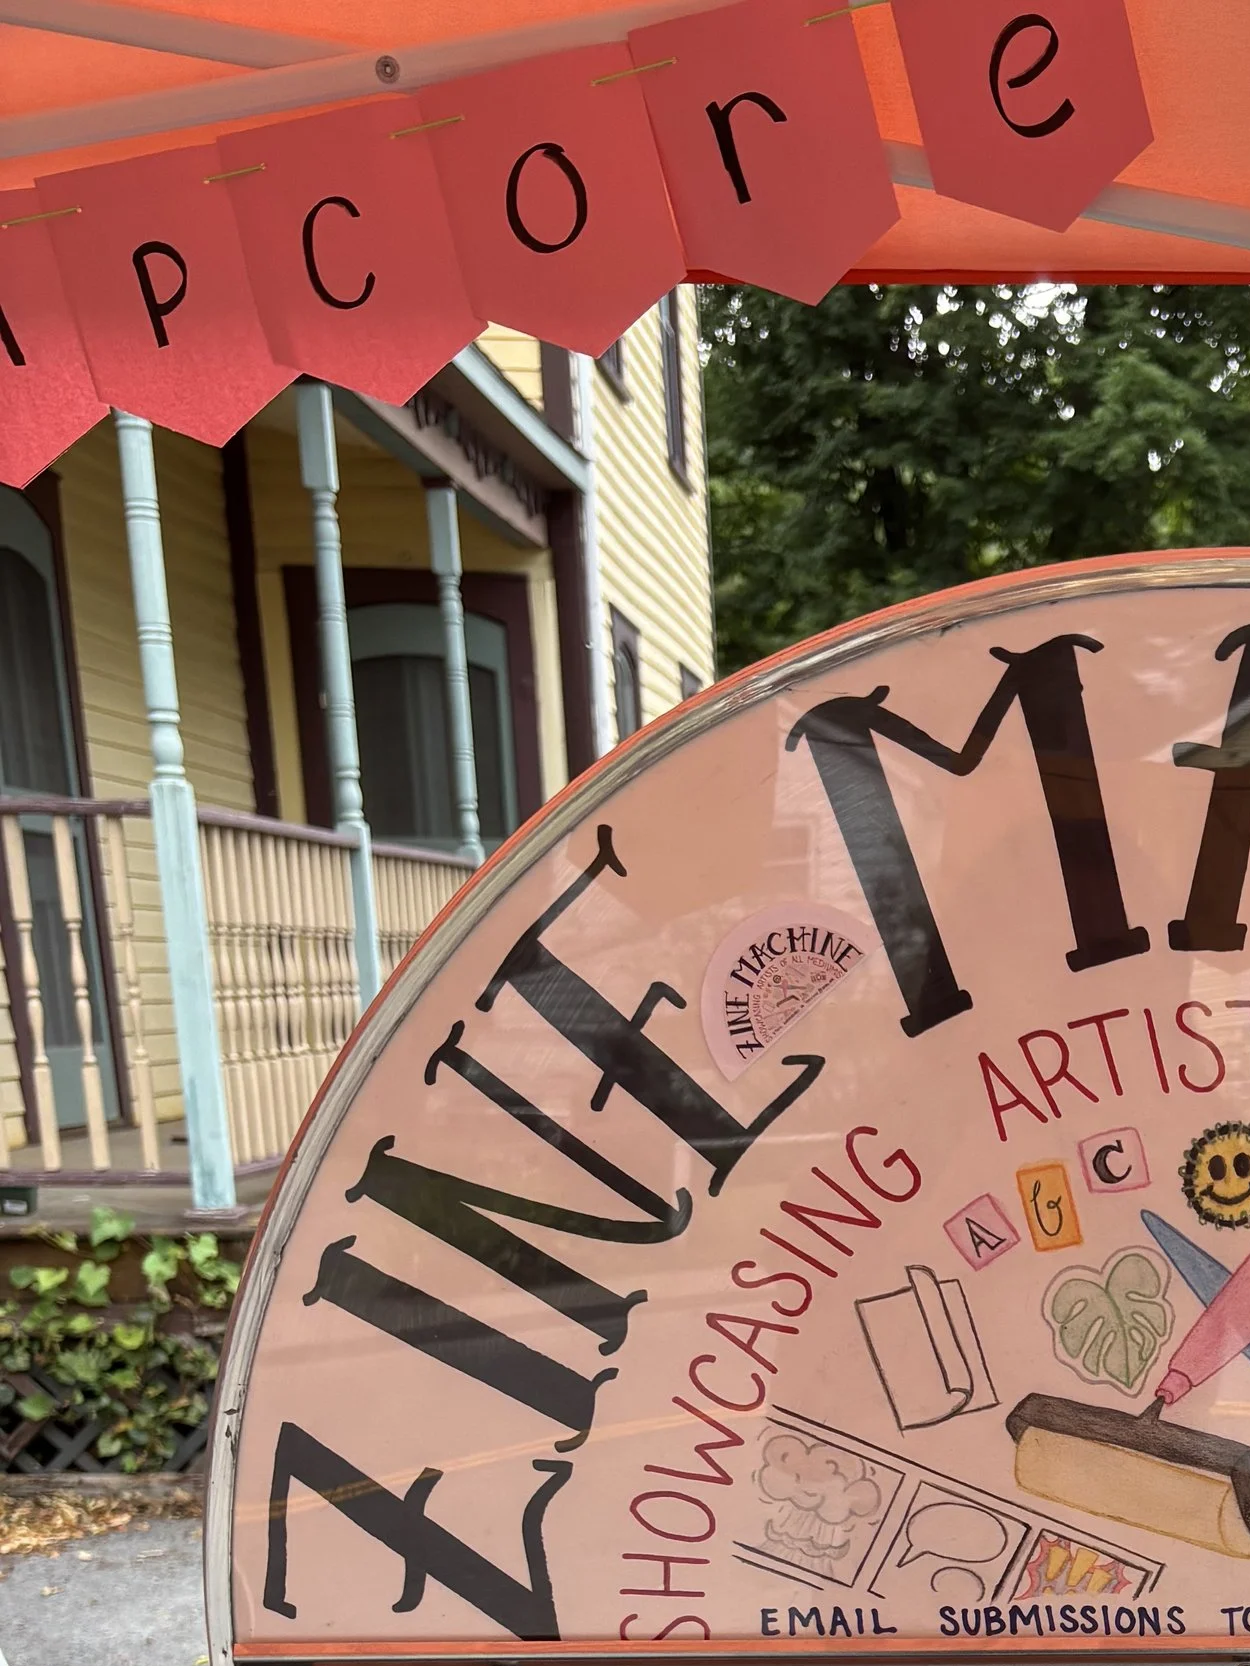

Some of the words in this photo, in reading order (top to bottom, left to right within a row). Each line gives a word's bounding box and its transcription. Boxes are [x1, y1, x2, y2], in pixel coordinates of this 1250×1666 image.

[730, 927, 865, 988] MACHINE
[724, 991, 764, 1059] ZINE
[263, 824, 824, 1641] ZINE
[620, 1126, 922, 1640] SHOWCASING
[761, 1606, 898, 1636] EMAIL
[940, 1605, 1186, 1635] SUBMISSIONS
